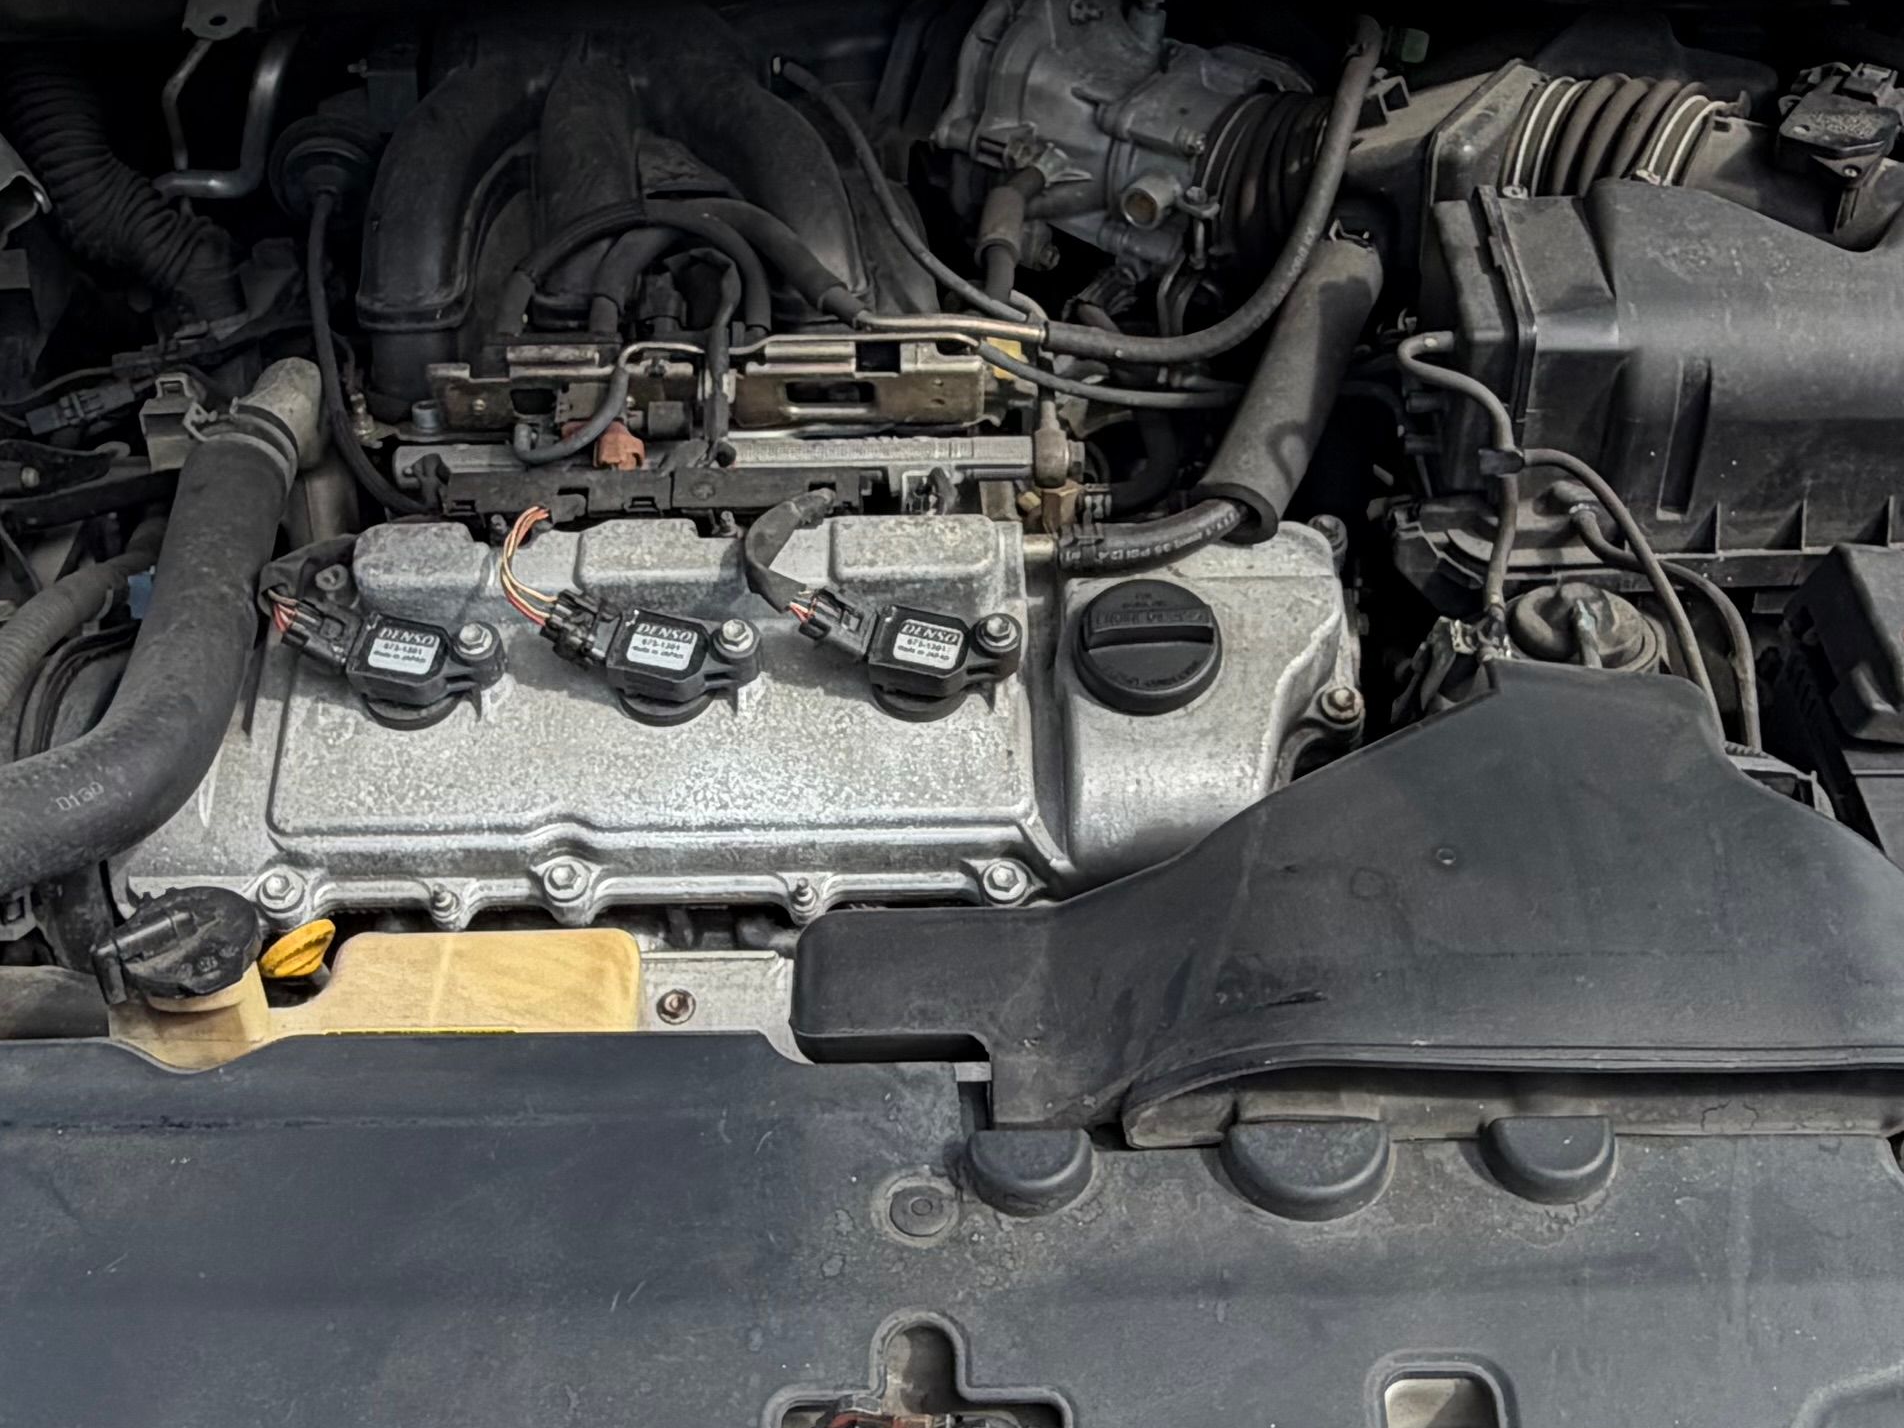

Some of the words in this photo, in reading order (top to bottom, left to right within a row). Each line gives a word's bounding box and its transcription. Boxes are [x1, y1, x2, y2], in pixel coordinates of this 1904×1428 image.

[378, 625, 435, 647] DENSO
[635, 621, 692, 642] DENSO
[900, 623, 958, 643] DENSO
